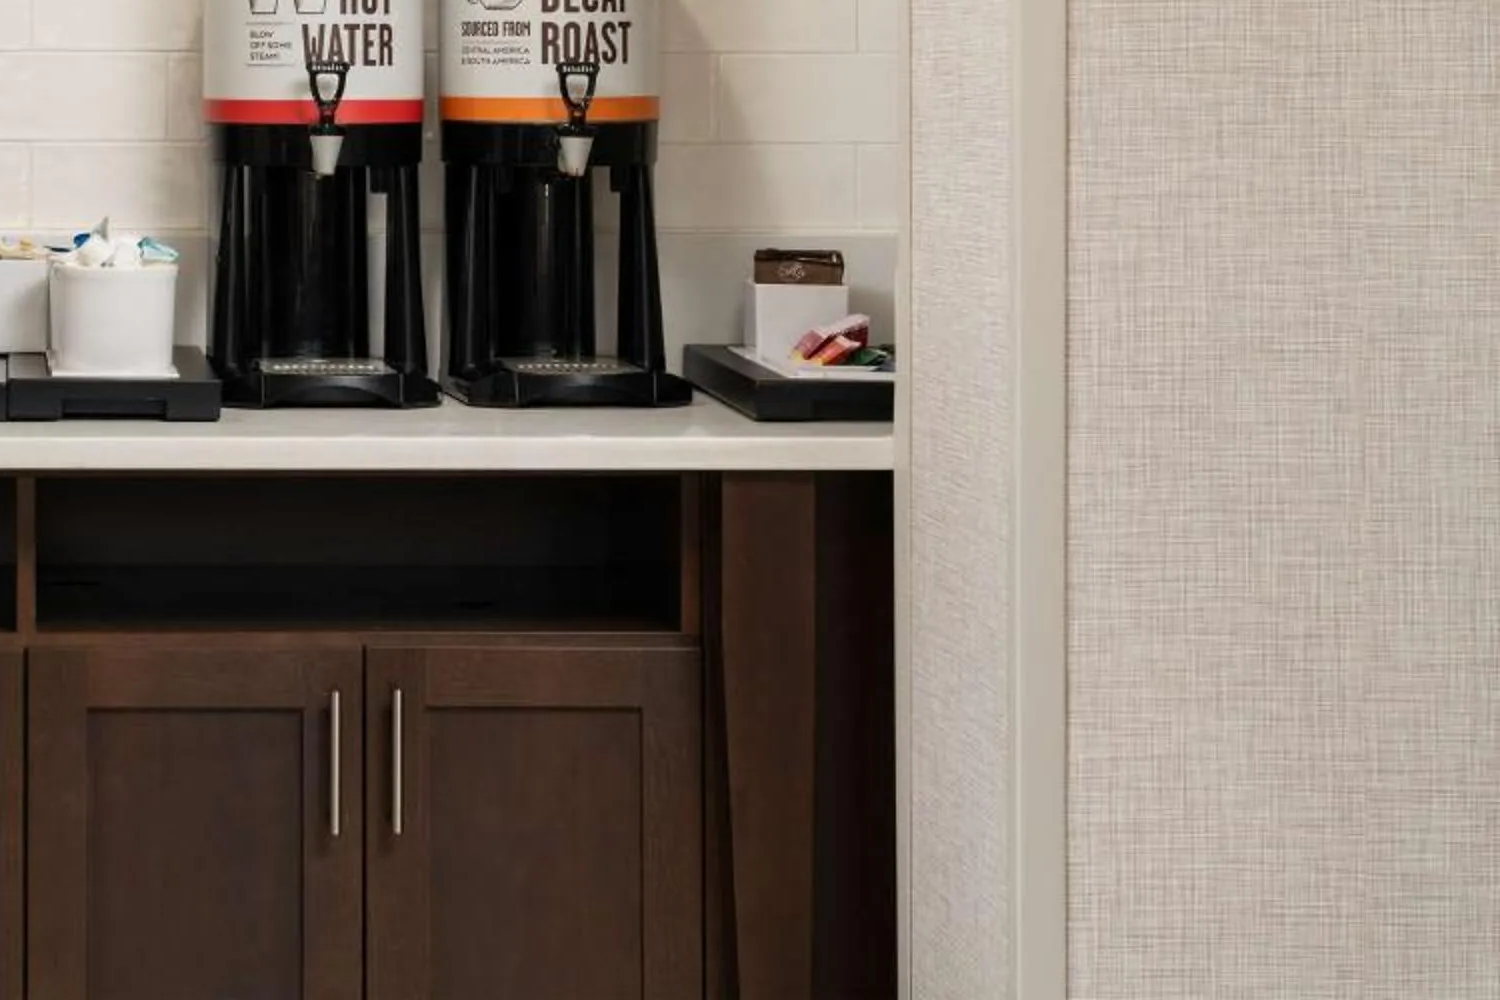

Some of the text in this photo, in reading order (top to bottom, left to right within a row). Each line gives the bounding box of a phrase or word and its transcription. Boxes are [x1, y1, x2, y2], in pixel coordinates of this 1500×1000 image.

[302, 23, 394, 67] WATER
[461, 21, 531, 37] SOURCED FROM
[541, 21, 632, 65] ROAST
